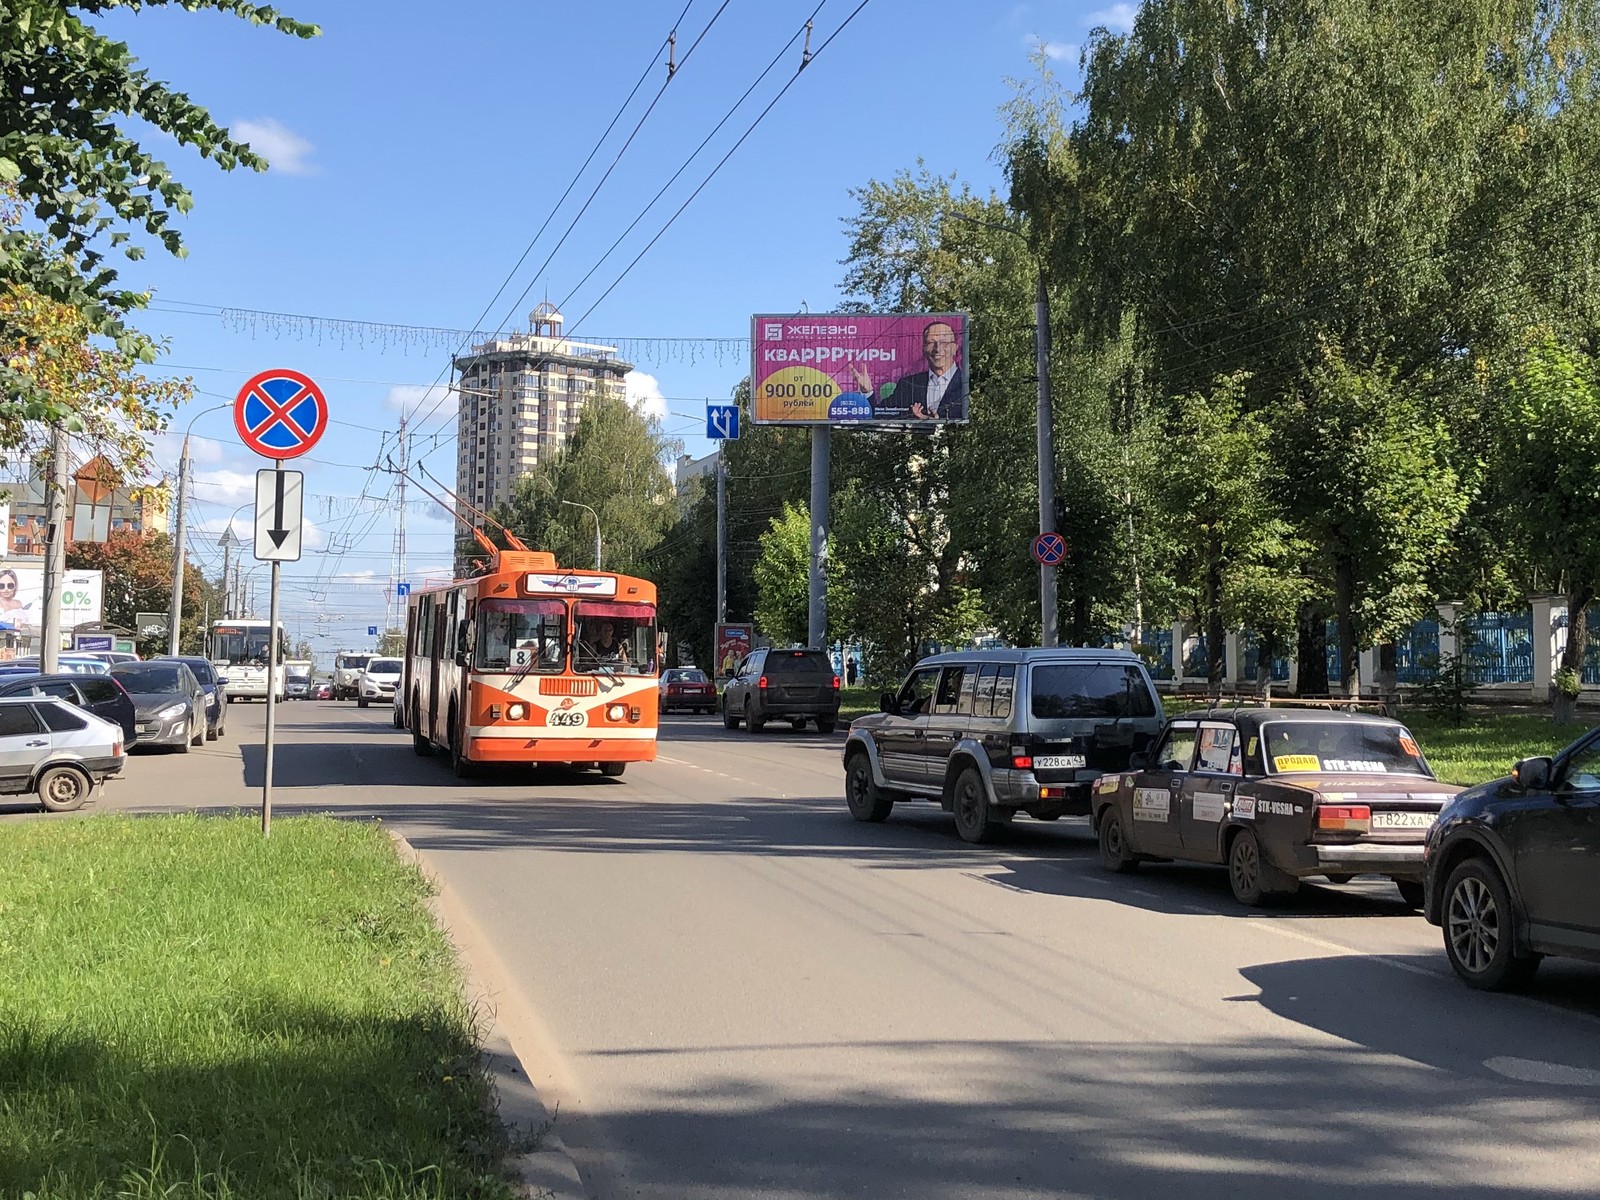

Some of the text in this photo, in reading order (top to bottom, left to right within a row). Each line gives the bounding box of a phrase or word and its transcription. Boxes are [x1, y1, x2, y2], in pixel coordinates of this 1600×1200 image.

[787, 325, 858, 335] ЖЕЛЕЗНО
[764, 346, 896, 363] КВАРРРТИРЫ
[765, 383, 833, 398] 900 000
[783, 399, 815, 408] рублей
[831, 406, 871, 416] 555-888
[516, 651, 525, 665] 8
[548, 712, 585, 727] 449
[1037, 755, 1084, 767] У228СА 43
[1277, 757, 1317, 766] ПРОДАЮ
[1257, 800, 1294, 816] STK-VGSHA
[1377, 812, 1424, 826] Т822ХА
